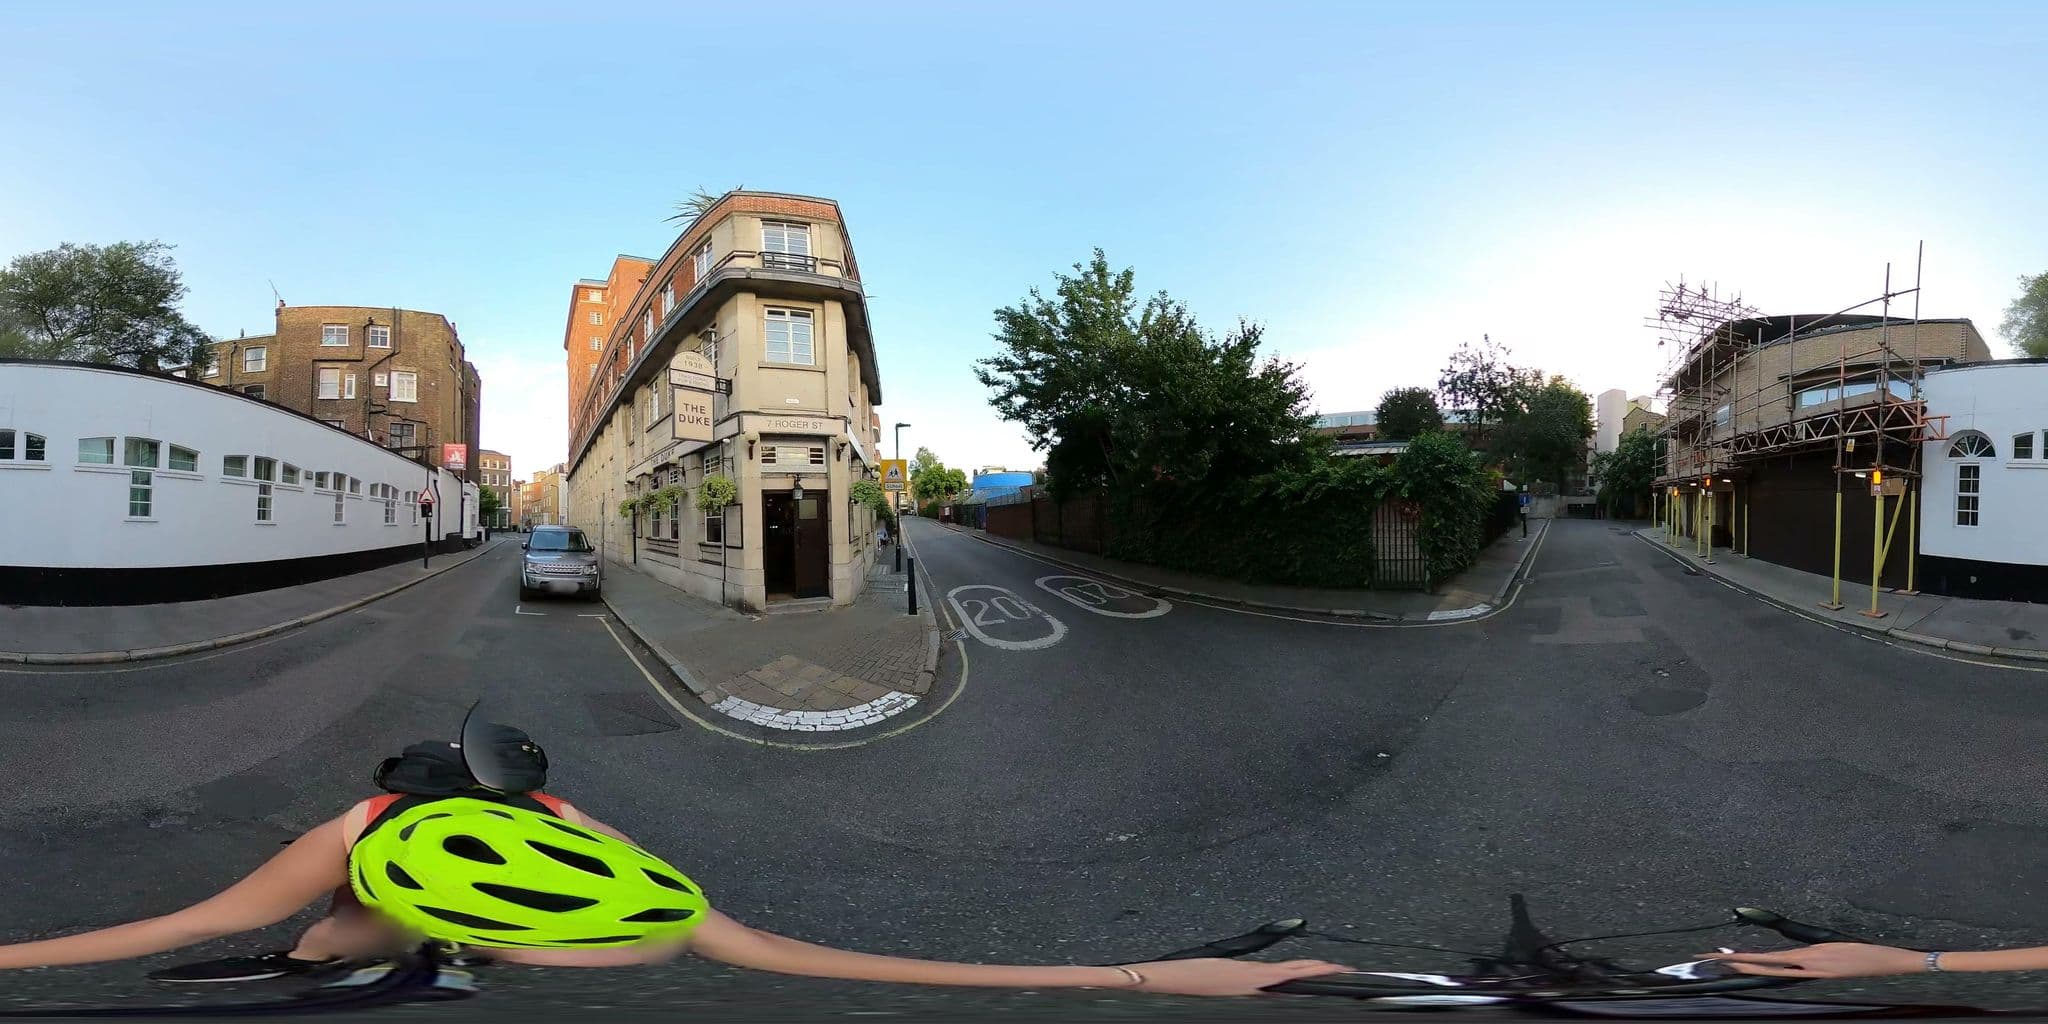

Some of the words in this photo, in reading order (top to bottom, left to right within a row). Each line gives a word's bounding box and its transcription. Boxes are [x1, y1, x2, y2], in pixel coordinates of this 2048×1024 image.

[684, 402, 706, 415] THE
[678, 413, 711, 427] DUKE
[767, 420, 772, 428] 7
[775, 420, 809, 429] ROGER
[811, 421, 824, 430] ST
[961, 596, 1032, 627] 20
